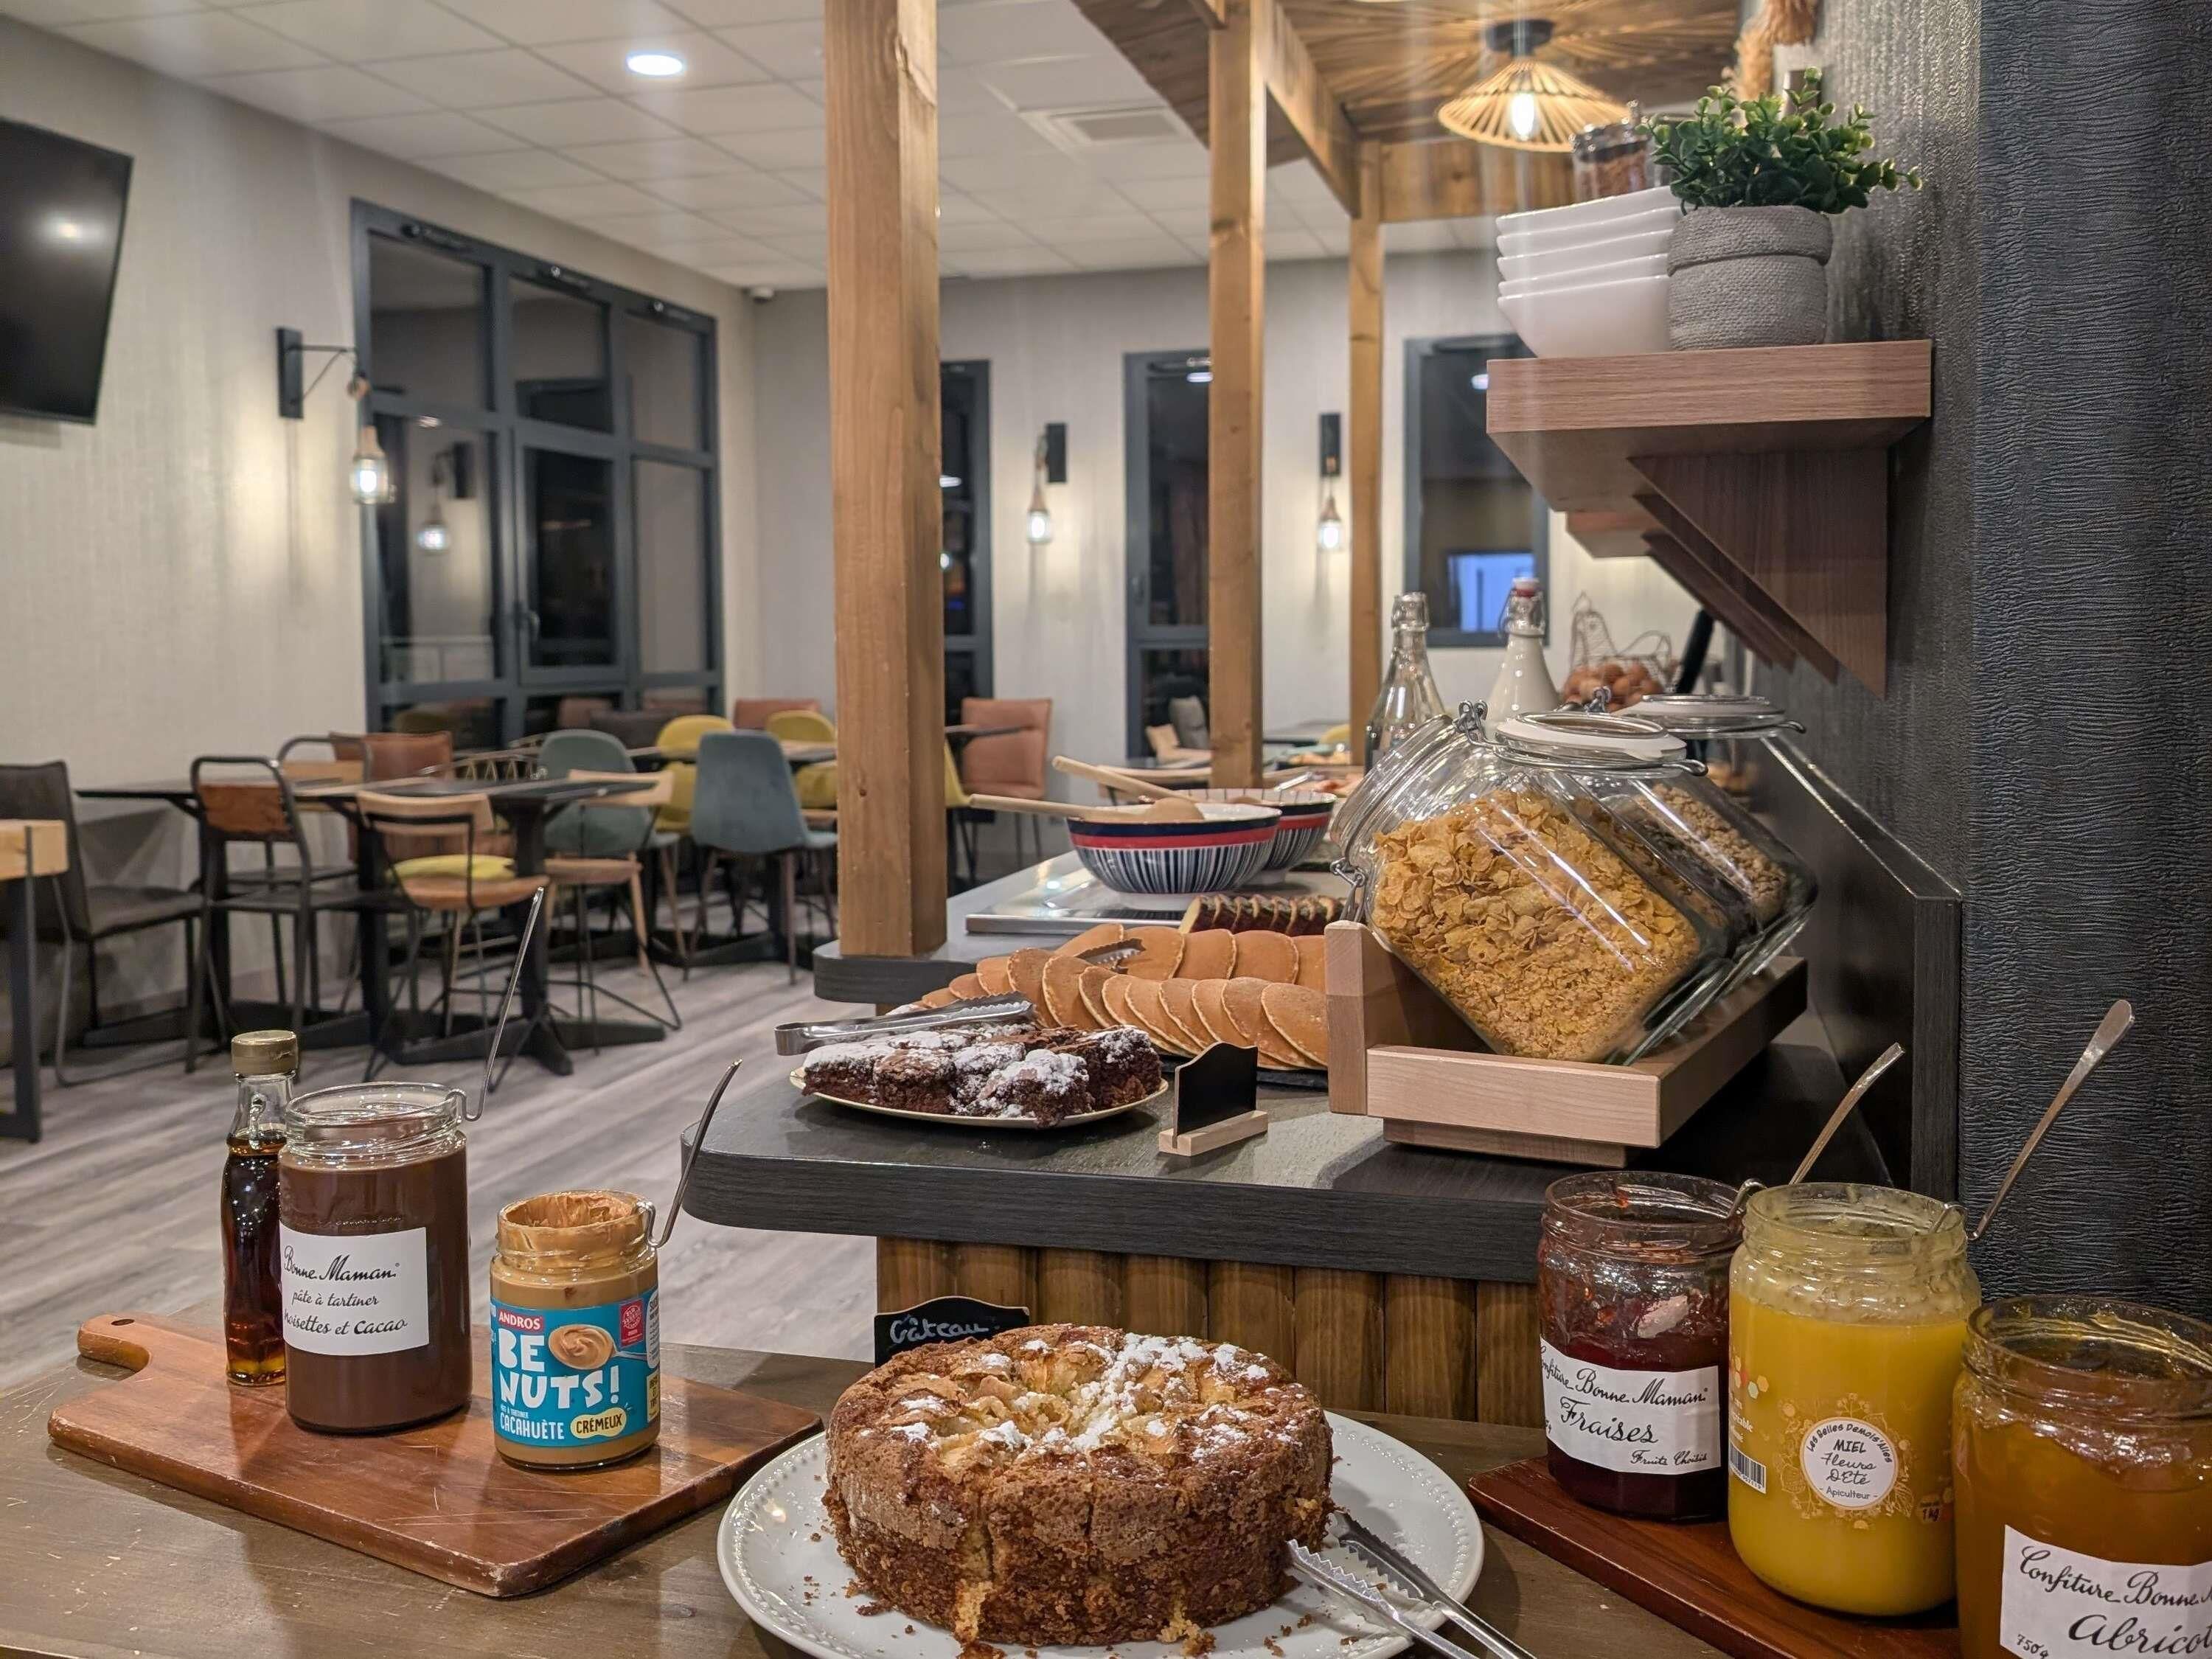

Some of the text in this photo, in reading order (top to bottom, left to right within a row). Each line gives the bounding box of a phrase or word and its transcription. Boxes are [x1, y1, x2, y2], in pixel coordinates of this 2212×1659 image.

[284, 1245, 397, 1281] Bonne Maman
[291, 1290, 380, 1307] pâte à tartiner
[335, 1320, 350, 1335] et
[353, 1317, 408, 1335] Cacao
[498, 1311, 541, 1330] ANDROS
[498, 1328, 545, 1372] BE
[499, 1365, 619, 1409] NUTS!
[1575, 1368, 1630, 1403] Bonne
[1632, 1377, 1706, 1406] Maman
[500, 1411, 565, 1440] CACAHUÈTE
[576, 1413, 622, 1433] CRÉMEUX
[1559, 1396, 1659, 1444] Fraises
[1806, 1436, 1818, 1452] Les
[1816, 1424, 1844, 1439] Belles
[1833, 1439, 1866, 1454] MIEL
[1820, 1452, 1877, 1470] Fleurs
[1826, 1486, 1871, 1500] Apiculteur
[2020, 1546, 2200, 1606] Confiture Bonne
[2068, 1614, 2212, 1655] Abricot
